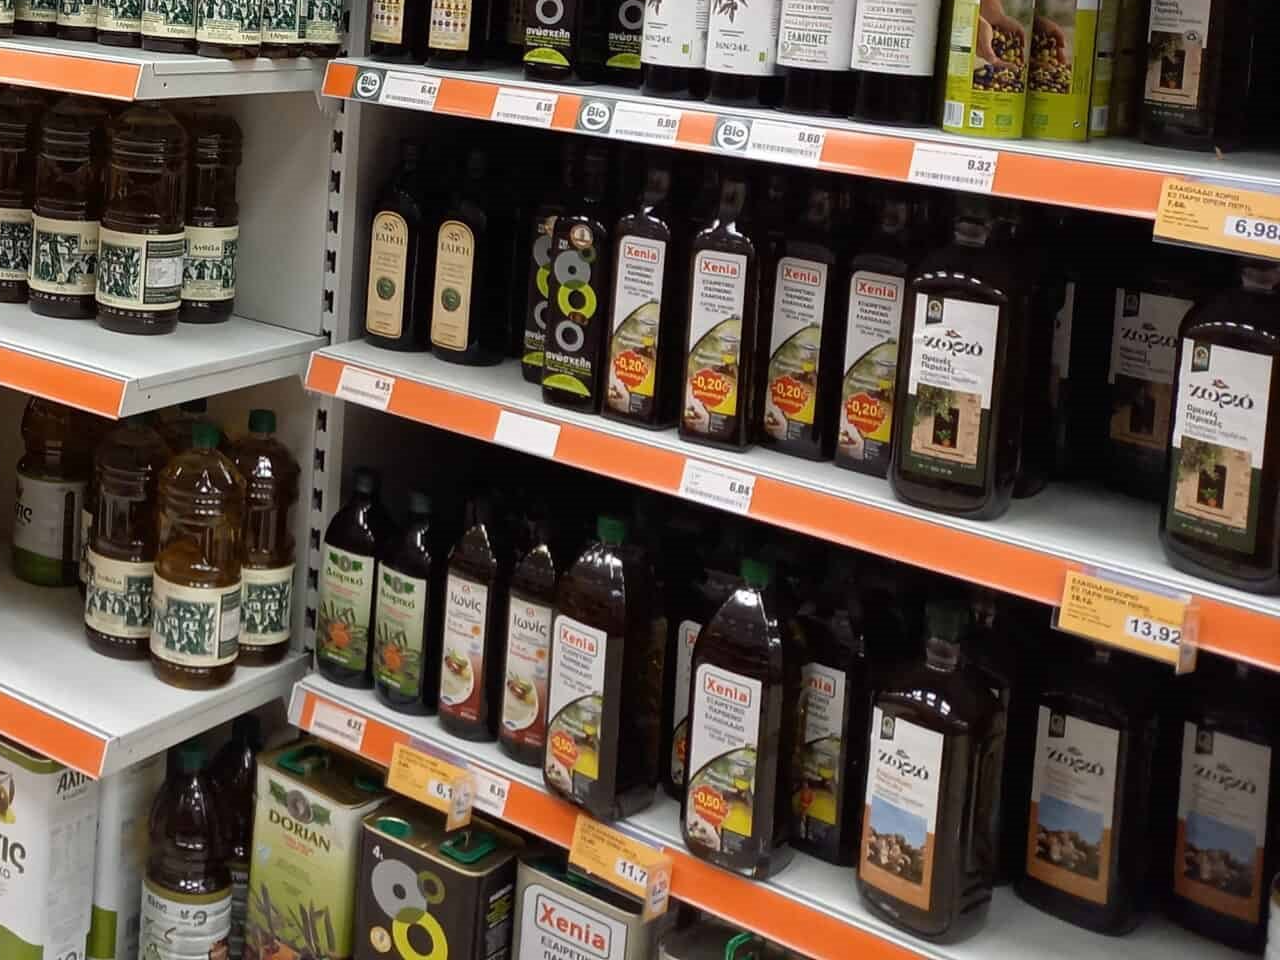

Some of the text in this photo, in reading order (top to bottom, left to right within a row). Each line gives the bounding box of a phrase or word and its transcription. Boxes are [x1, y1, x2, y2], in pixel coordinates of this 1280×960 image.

[361, 75, 377, 87] Bio
[587, 106, 606, 119] Bio
[723, 123, 745, 138] Bio
[627, 246, 657, 260] Xenia
[703, 261, 738, 276] Xenia
[784, 268, 818, 283] Xenia
[858, 281, 897, 298] Xenia
[922, 334, 984, 358] χωριό
[1188, 384, 1255, 411] χωριό
[560, 627, 597, 653] Xenia
[1130, 618, 1182, 646] 13,92
[705, 676, 751, 703] Xenia
[807, 675, 833, 695] nia
[268, 808, 332, 853] DORIAN
[541, 901, 606, 951] Xenia
